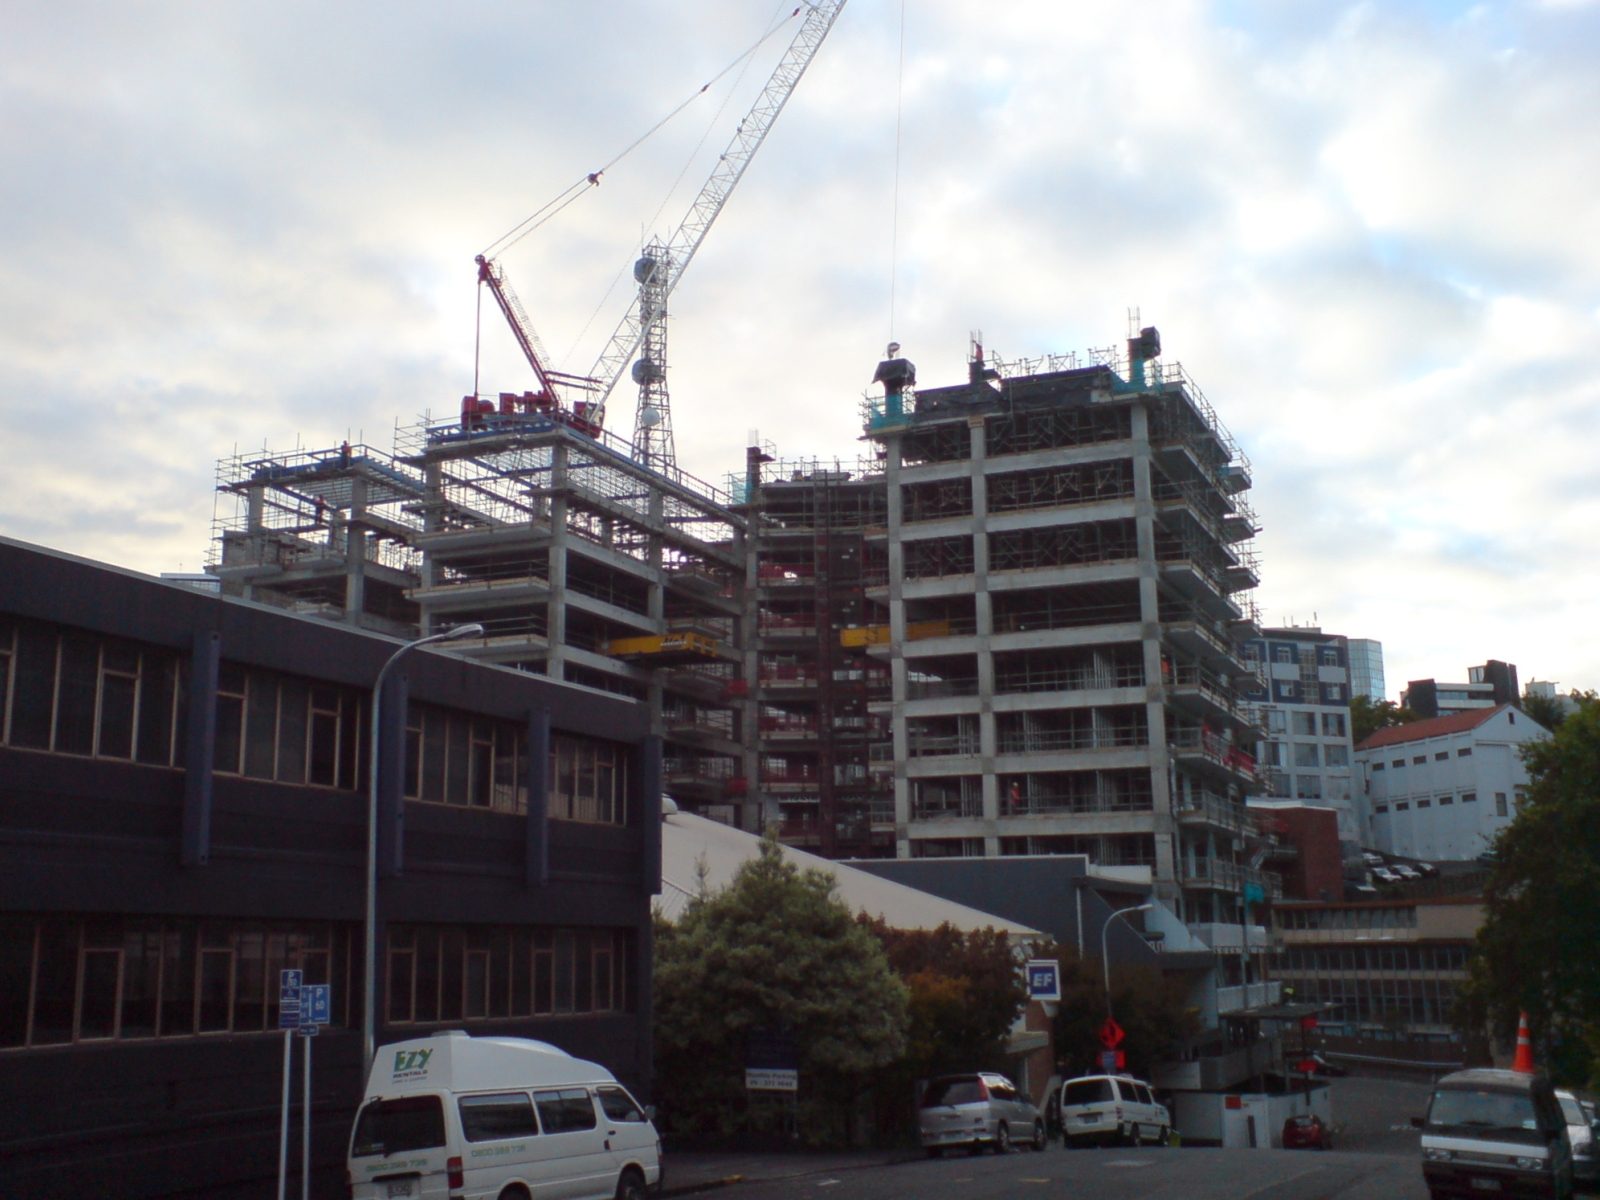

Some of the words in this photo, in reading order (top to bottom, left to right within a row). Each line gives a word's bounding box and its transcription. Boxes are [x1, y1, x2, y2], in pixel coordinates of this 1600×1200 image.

[1033, 972, 1053, 987] EF
[316, 987, 323, 998] P
[394, 1048, 433, 1072] EZY
